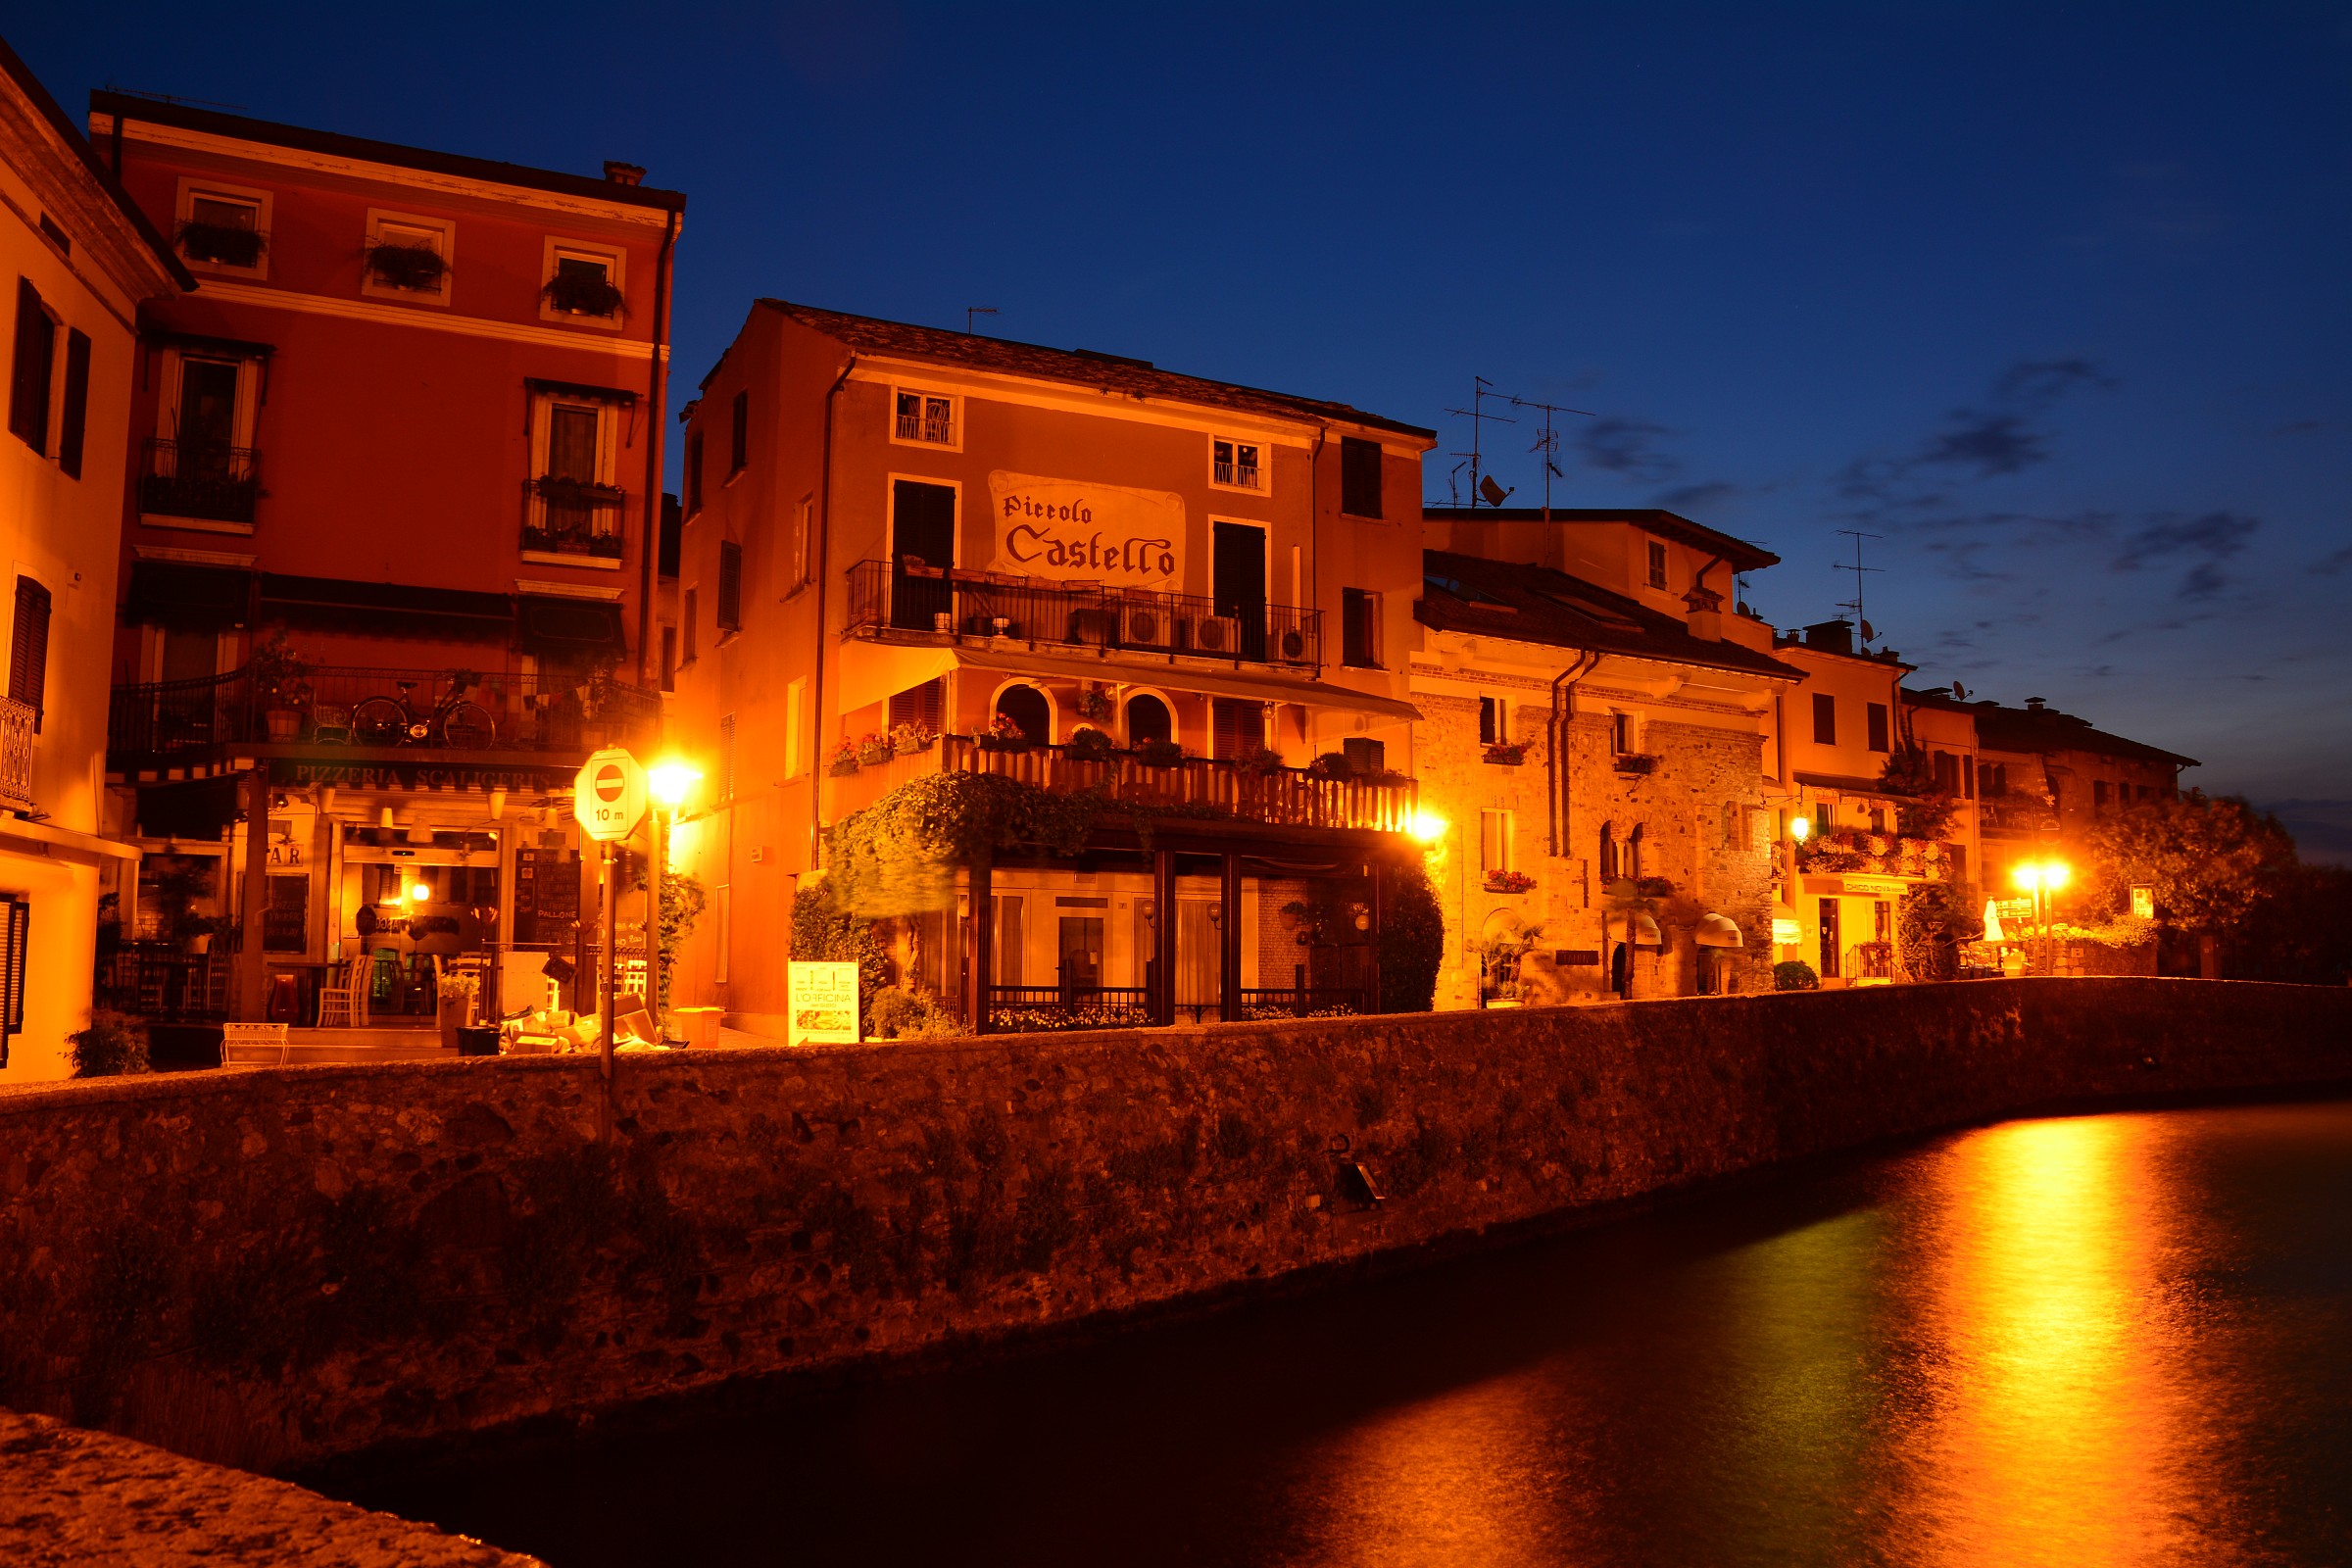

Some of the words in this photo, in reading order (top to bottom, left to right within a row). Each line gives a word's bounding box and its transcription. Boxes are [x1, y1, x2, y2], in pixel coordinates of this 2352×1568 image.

[1003, 495, 1092, 524] Piccolo
[1005, 524, 1175, 576] Castello
[297, 765, 402, 784] PIZZERIA
[596, 808, 610, 821] 10
[614, 811, 624, 820] m
[270, 847, 300, 864] AR
[537, 909, 577, 919] PALLONE
